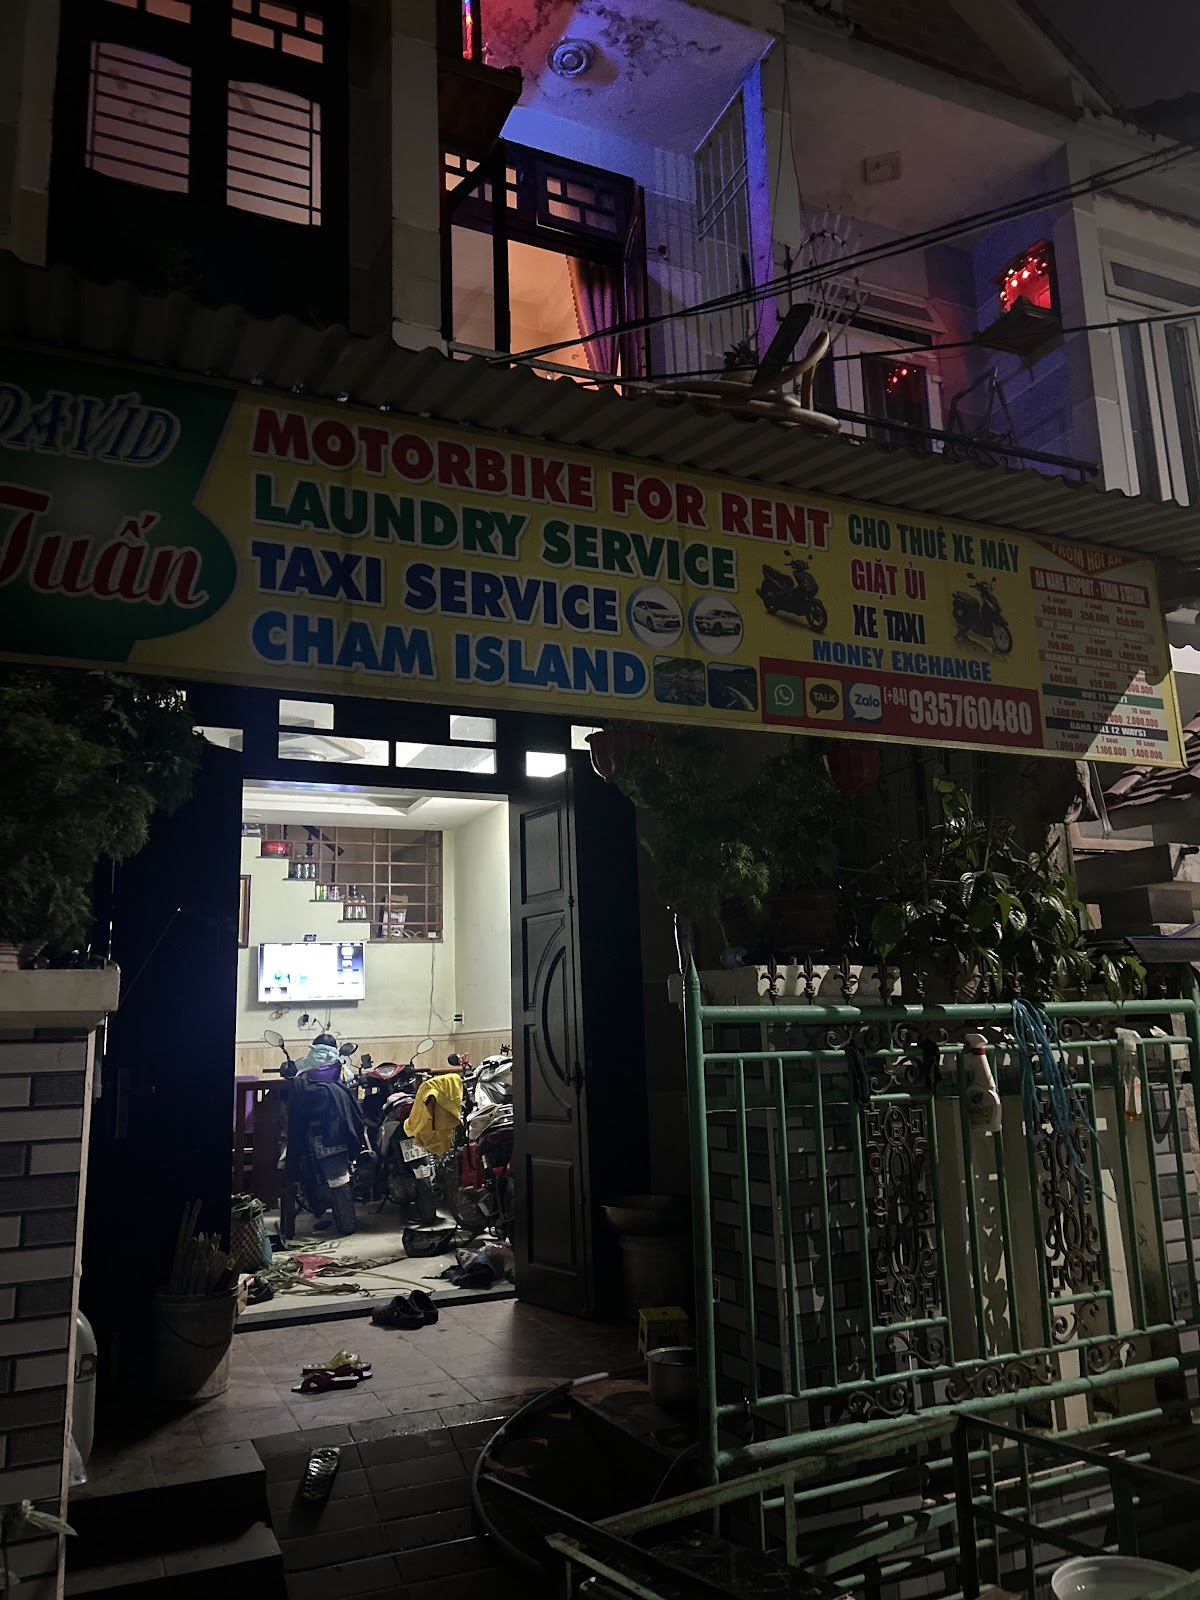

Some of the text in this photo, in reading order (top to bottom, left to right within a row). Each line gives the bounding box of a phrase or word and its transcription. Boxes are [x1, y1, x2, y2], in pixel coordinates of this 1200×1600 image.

[253, 408, 829, 548] MOTORBIKE FOR RENT
[0, 484, 207, 605] Tuấn
[255, 473, 736, 589] LAUNDRY SERVICE
[849, 513, 1019, 573] CHO THUÊ XE MÁY
[851, 557, 926, 600] GIẶT ỦI
[1052, 543, 1085, 568] FROM
[1087, 550, 1105, 571] HOI
[252, 541, 618, 632] TAXI SERVICE
[853, 604, 926, 645] XE TAXI
[252, 611, 646, 695] CHAM ISLAND
[812, 639, 992, 682] MONEY EXCHANGE
[812, 691, 836, 704] TALK
[853, 694, 880, 708] Zalo
[883, 685, 1033, 736] (+84) 935760480
[1121, 727, 1147, 738] WAYS)
